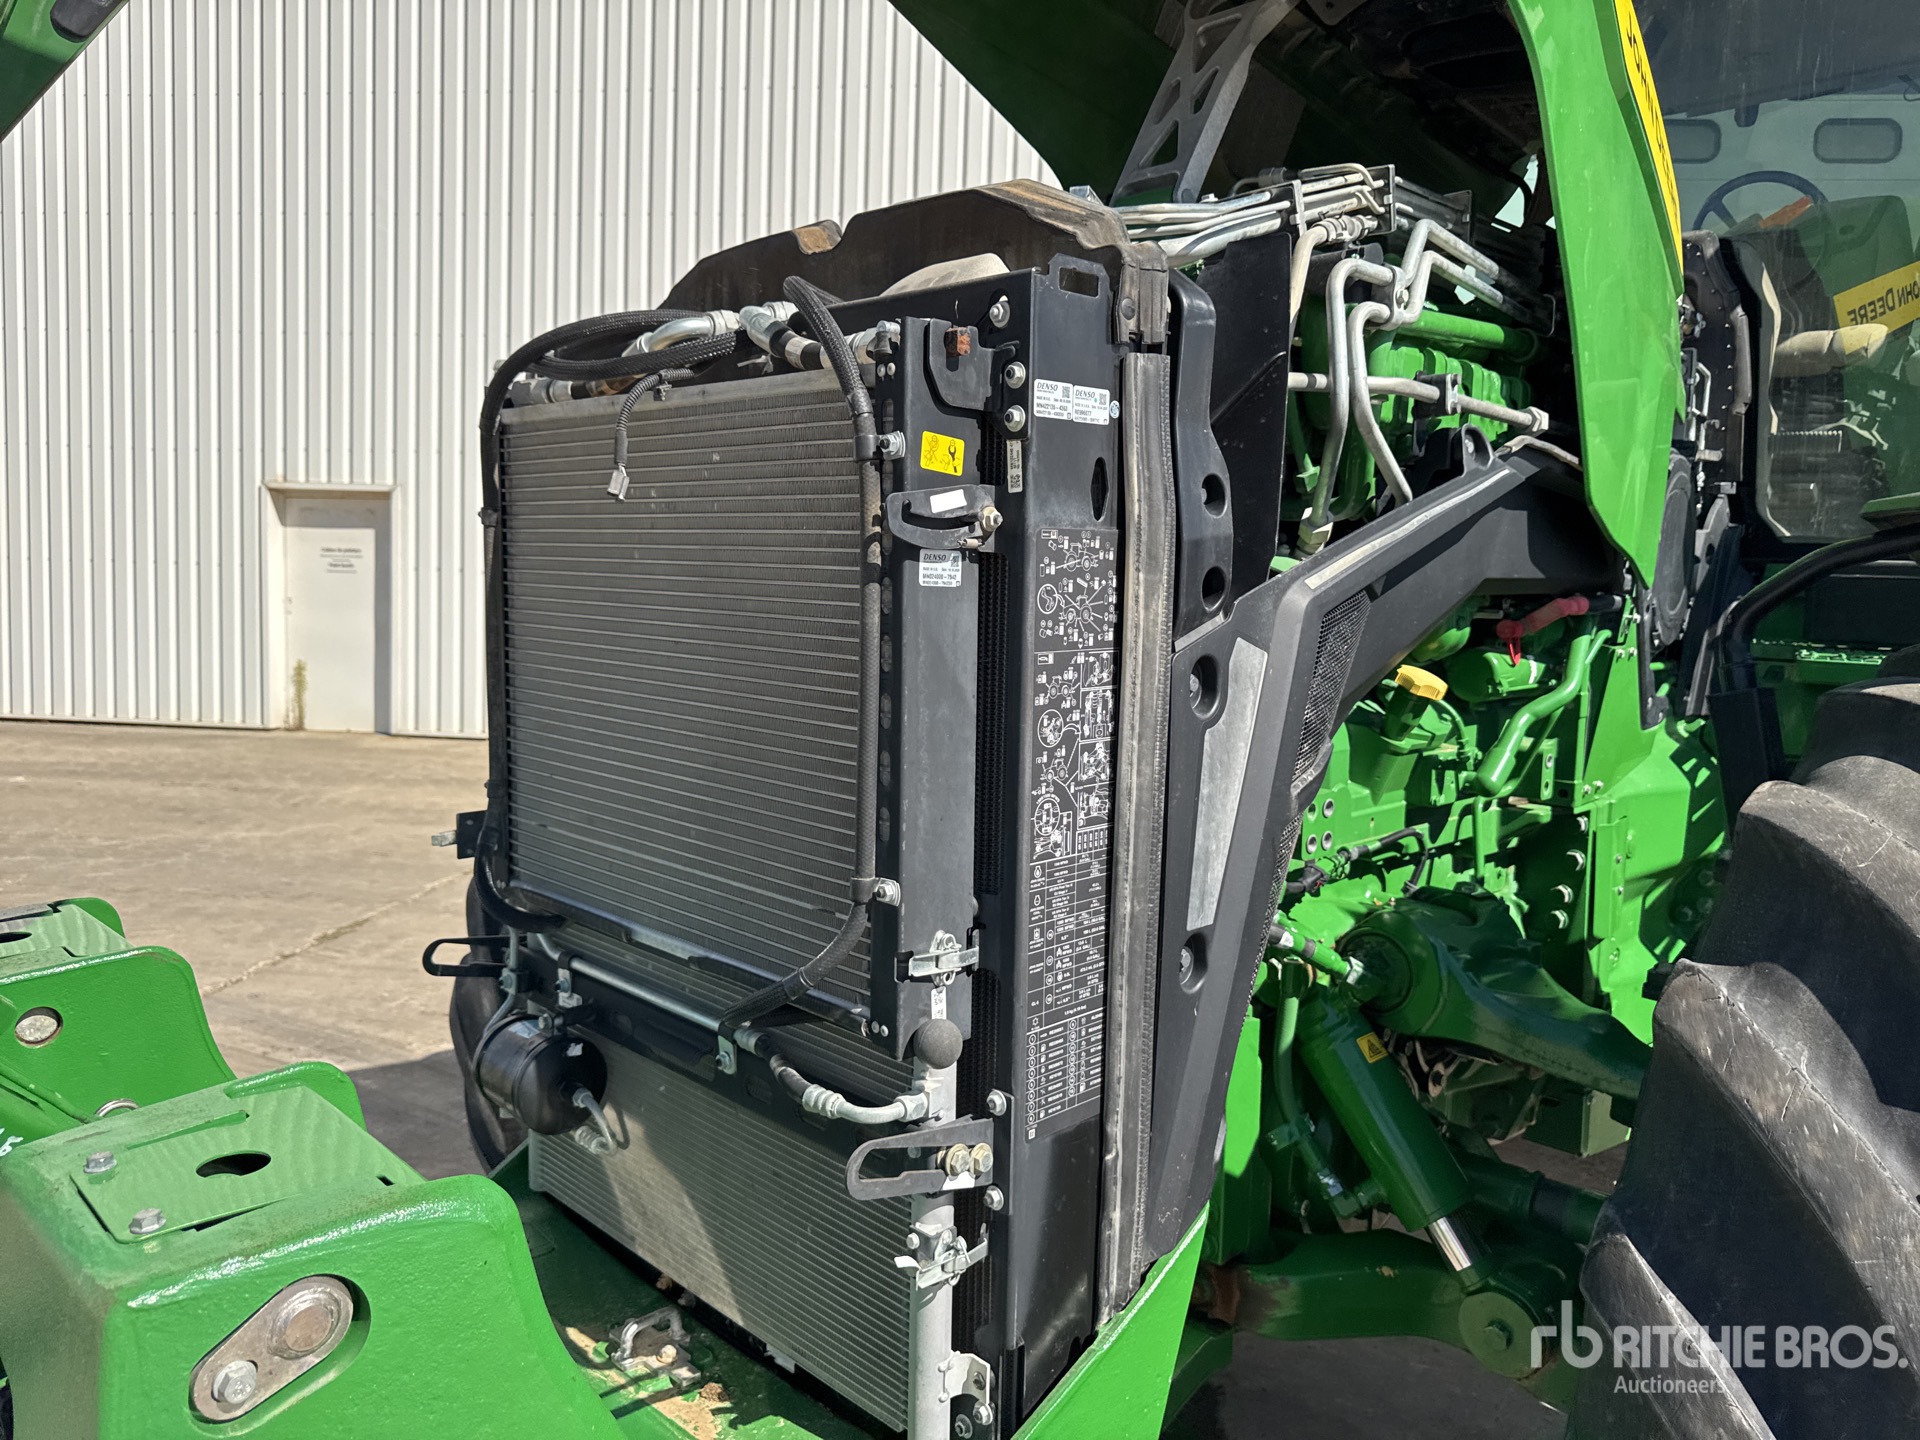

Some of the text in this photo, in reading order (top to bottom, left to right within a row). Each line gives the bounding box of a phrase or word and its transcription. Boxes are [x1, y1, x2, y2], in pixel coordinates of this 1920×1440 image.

[1037, 382, 1058, 391] DENSO
[1075, 390, 1096, 399] DENSO
[923, 553, 947, 561] DENSO
